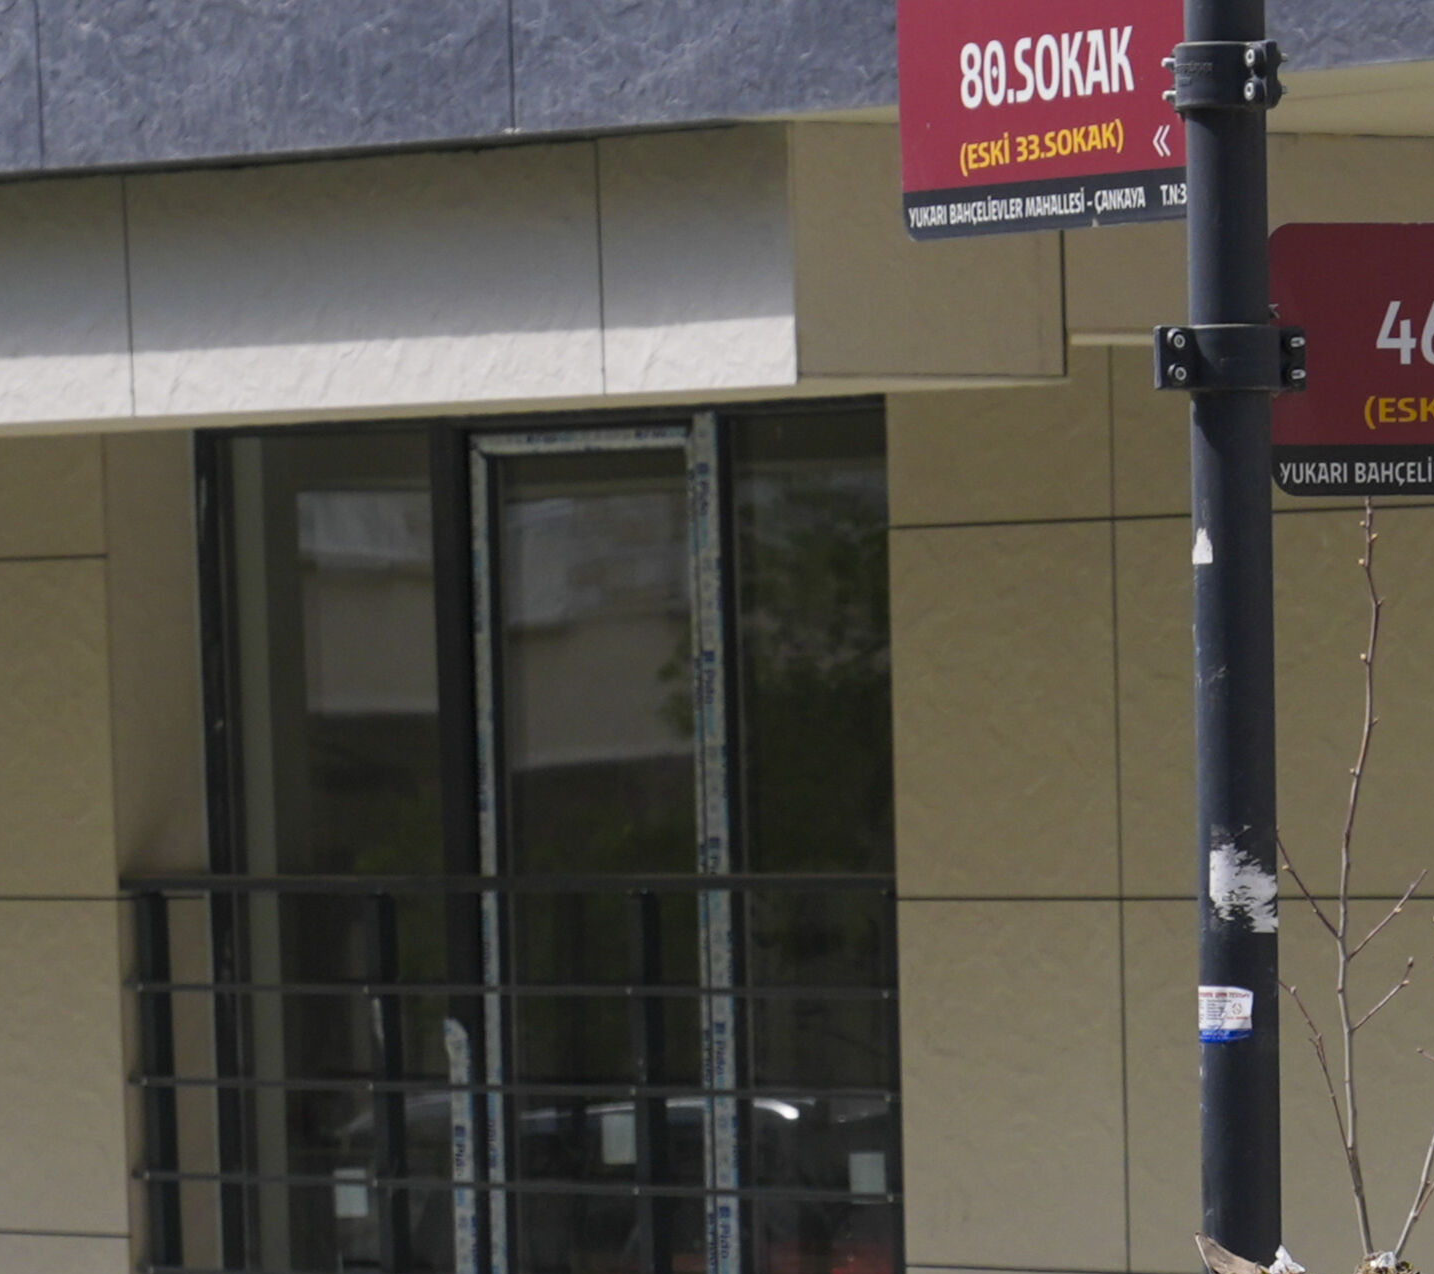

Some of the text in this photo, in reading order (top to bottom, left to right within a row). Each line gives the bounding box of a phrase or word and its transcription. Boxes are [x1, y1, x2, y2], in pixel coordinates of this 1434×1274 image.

[960, 26, 1135, 109] 80.SOKAK
[960, 118, 1124, 177] (ESKİ 33.SOKAK)
[909, 204, 948, 228] YUKARI
[949, 195, 1024, 226] BAHÇELİEVLER
[1025, 187, 1085, 218] MAHALLESİ
[1094, 186, 1146, 214] ÇANKAYA
[1279, 461, 1349, 485] YUKARI
